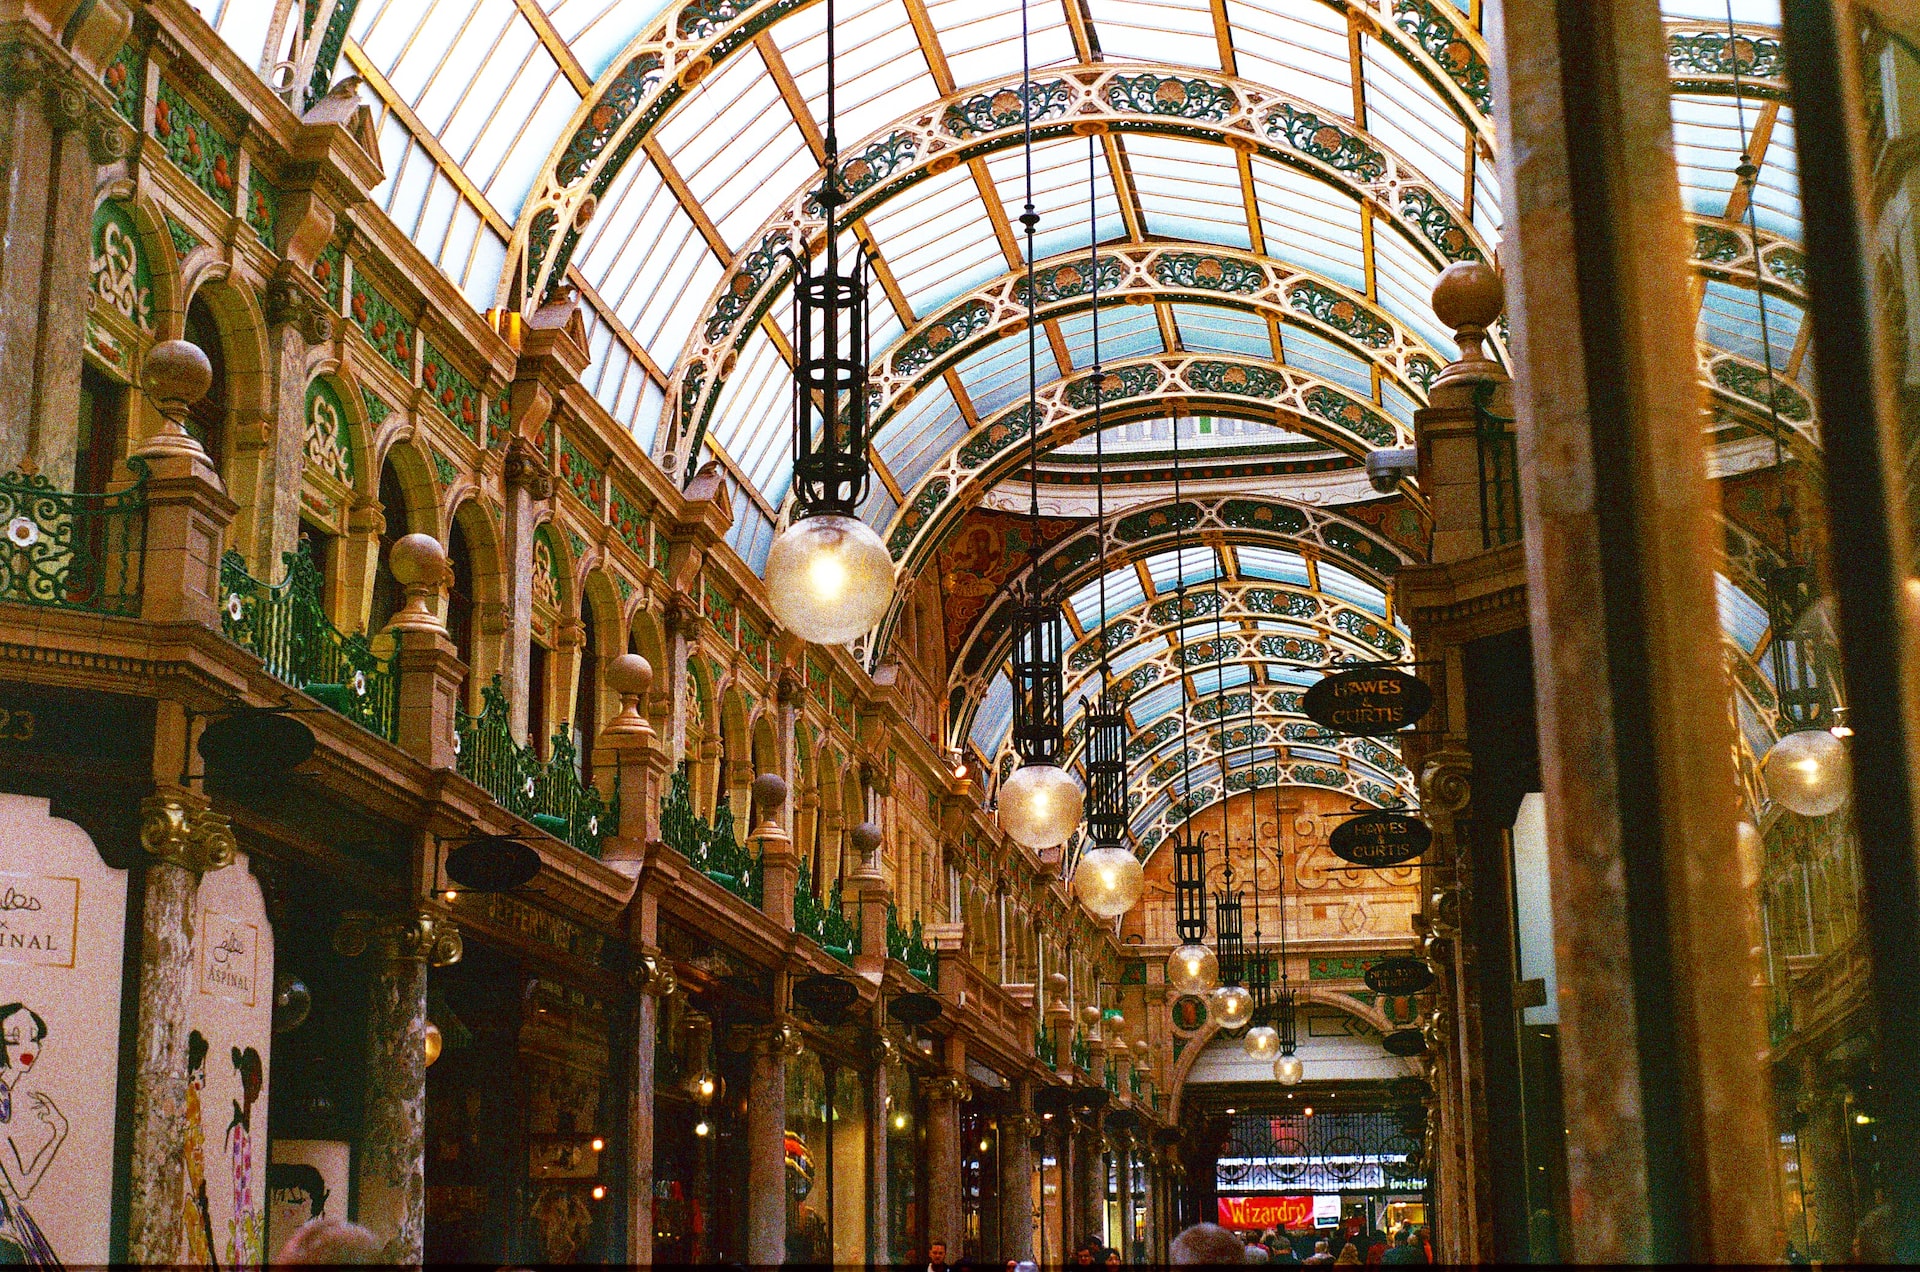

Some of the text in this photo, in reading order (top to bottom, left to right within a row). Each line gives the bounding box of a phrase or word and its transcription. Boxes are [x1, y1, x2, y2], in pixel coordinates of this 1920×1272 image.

[1333, 680, 1402, 697] HAWES
[1362, 696, 1373, 708] &
[1332, 707, 1404, 724] CURTIS
[1354, 822, 1408, 835] HAWES
[1352, 844, 1410, 857] CURTIS
[207, 965, 248, 991] ASPINAL
[1228, 1198, 1307, 1228] Wizardry
